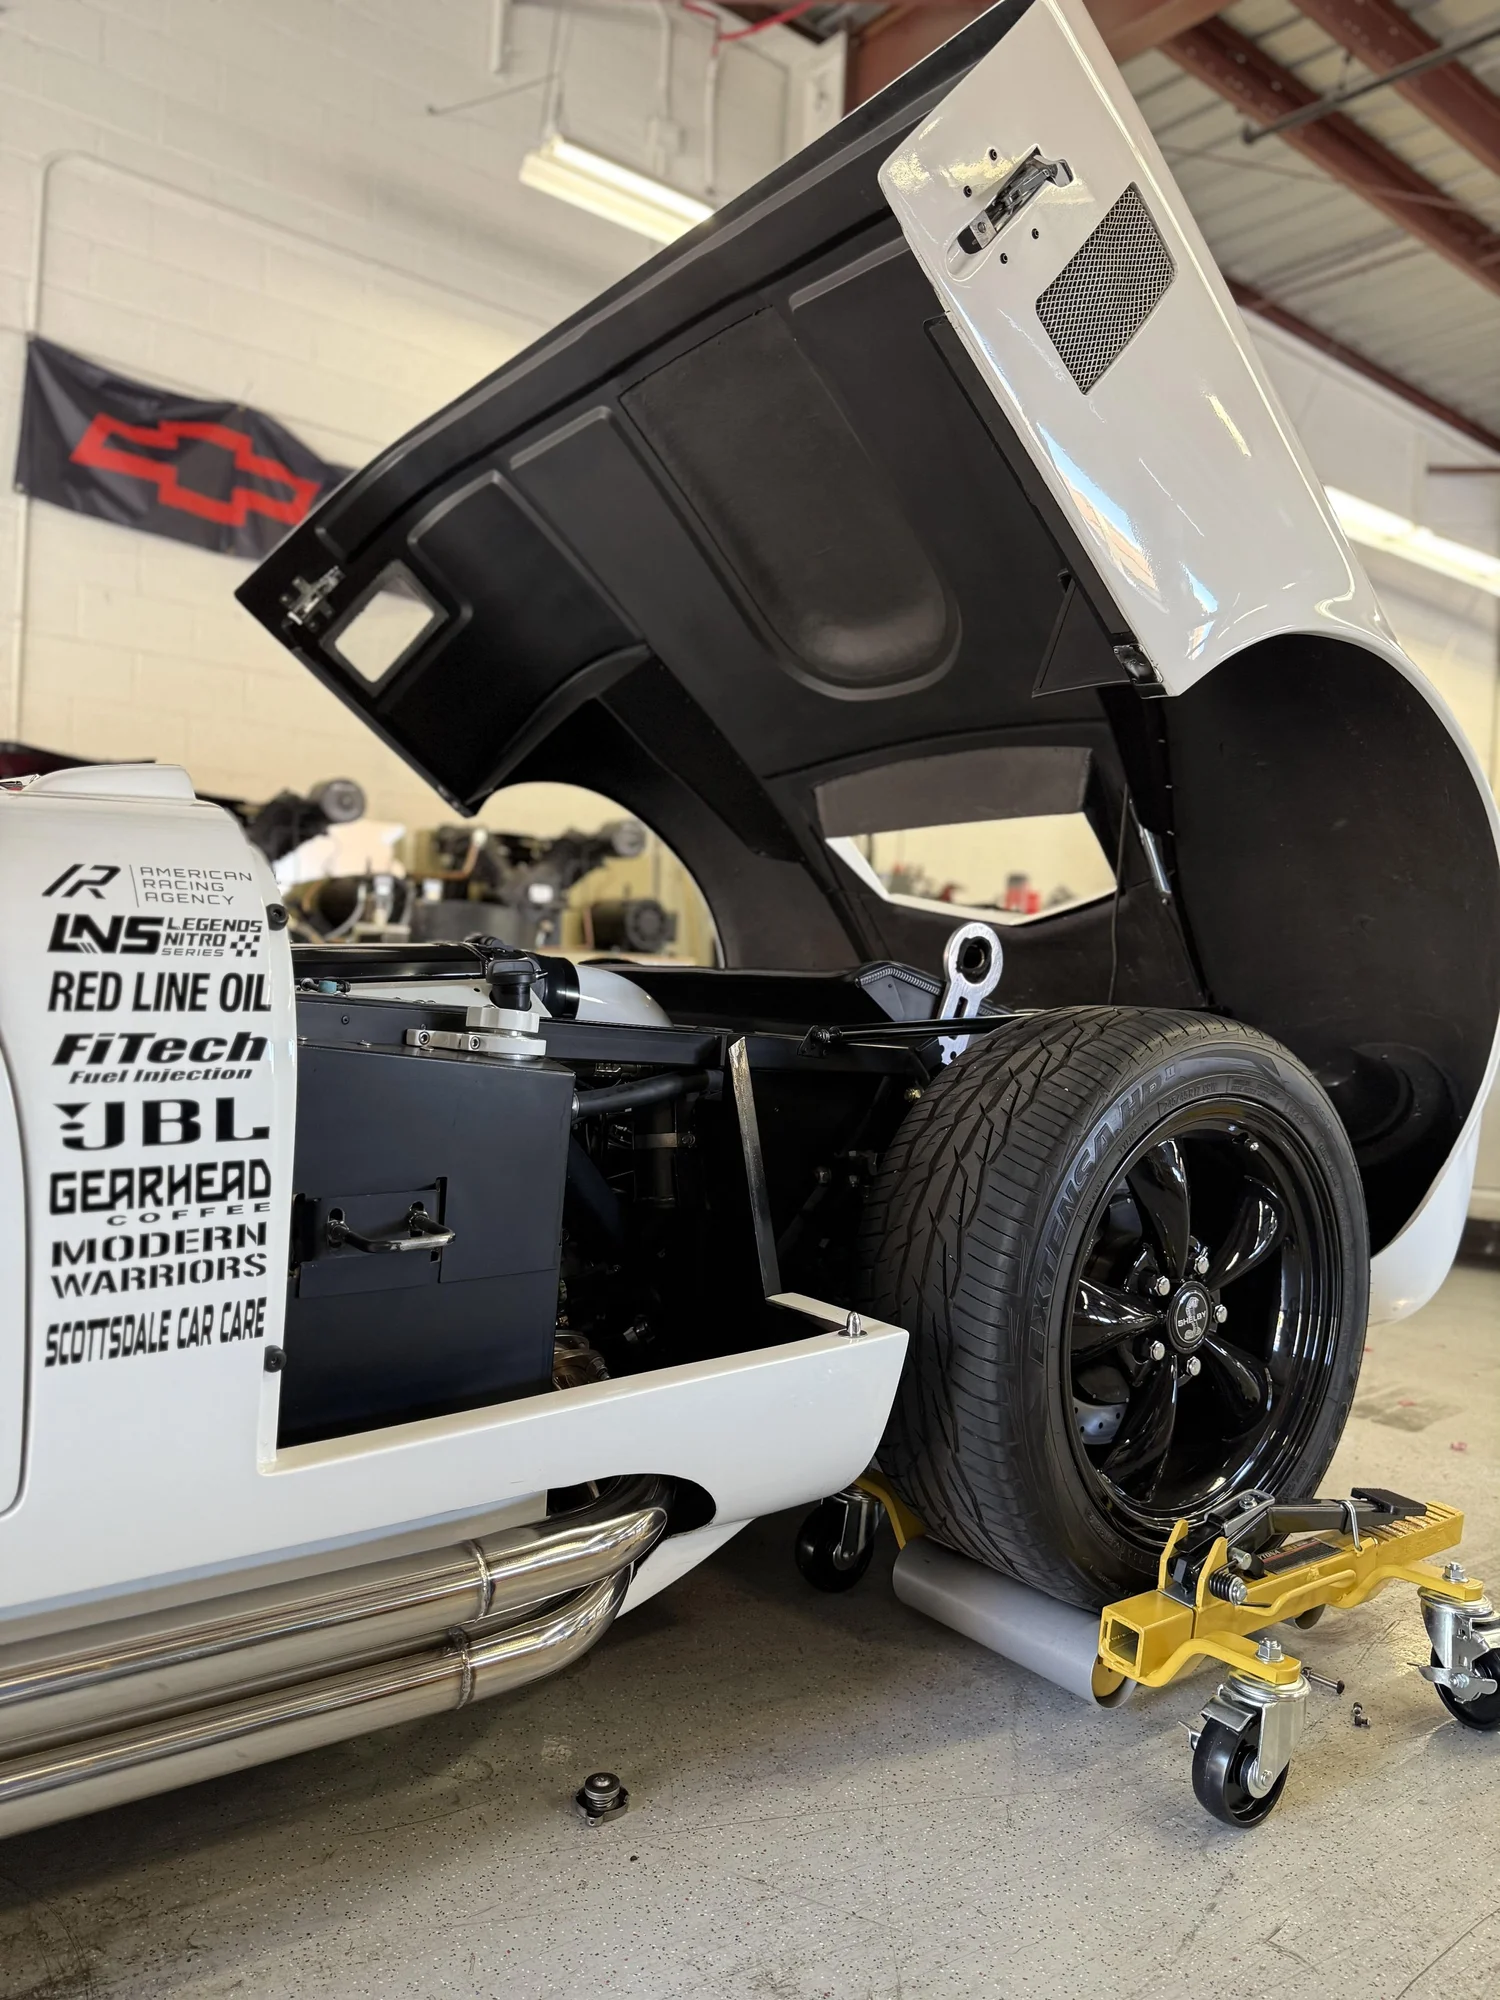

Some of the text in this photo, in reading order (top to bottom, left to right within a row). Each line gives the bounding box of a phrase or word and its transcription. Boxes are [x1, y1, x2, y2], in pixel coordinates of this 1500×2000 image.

[139, 866, 253, 882] AMERICAN
[142, 879, 225, 893] RACING
[144, 891, 235, 906] AGENCY
[47, 913, 165, 955] LNS
[163, 932, 226, 947] NITRO
[166, 917, 263, 933] LEGENDS
[161, 948, 224, 957] SERIES
[47, 970, 272, 1013] RED LINE OIL
[52, 1031, 268, 1066] FiTech
[68, 1067, 253, 1084] Fuel Injection
[58, 1096, 270, 1151] JBL
[49, 1158, 272, 1216] GEARHEAD
[106, 1201, 271, 1226] COFFEE
[51, 1221, 267, 1268] MODERN
[1028, 1119, 1115, 1366] EXTENSA
[50, 1253, 267, 1299] WARRIORS
[44, 1296, 268, 1367] SCOTTSDALE CAR CARE
[1177, 1310, 1207, 1328] SHELBY
